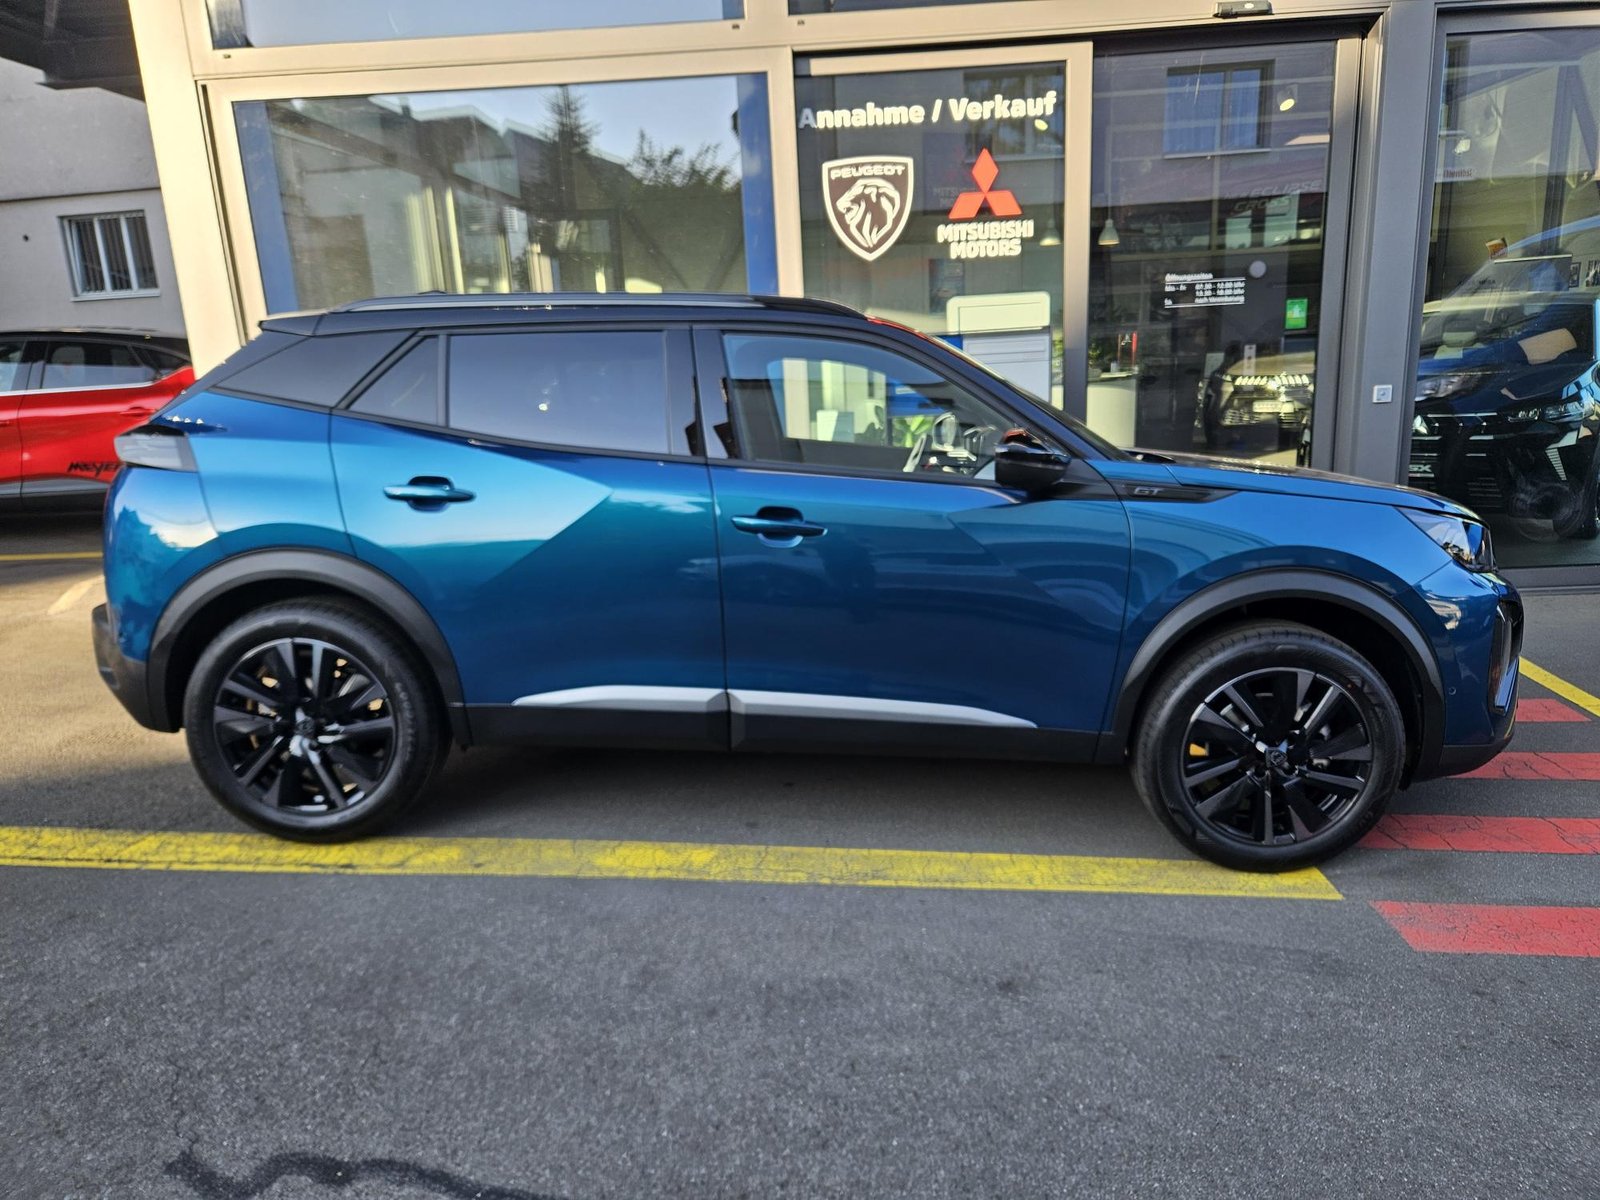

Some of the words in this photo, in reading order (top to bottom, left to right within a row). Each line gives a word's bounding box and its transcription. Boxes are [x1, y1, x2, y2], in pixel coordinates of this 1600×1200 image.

[798, 101, 925, 129] Annahme
[931, 98, 943, 123] /
[948, 90, 1057, 121] Verkauf
[830, 164, 906, 181] PEUGEOT
[1249, 180, 1322, 198] ECLIPSE
[937, 219, 1034, 243] MITSUBISHI
[950, 237, 1022, 260] MOTORS
[1134, 486, 1164, 495] GT
